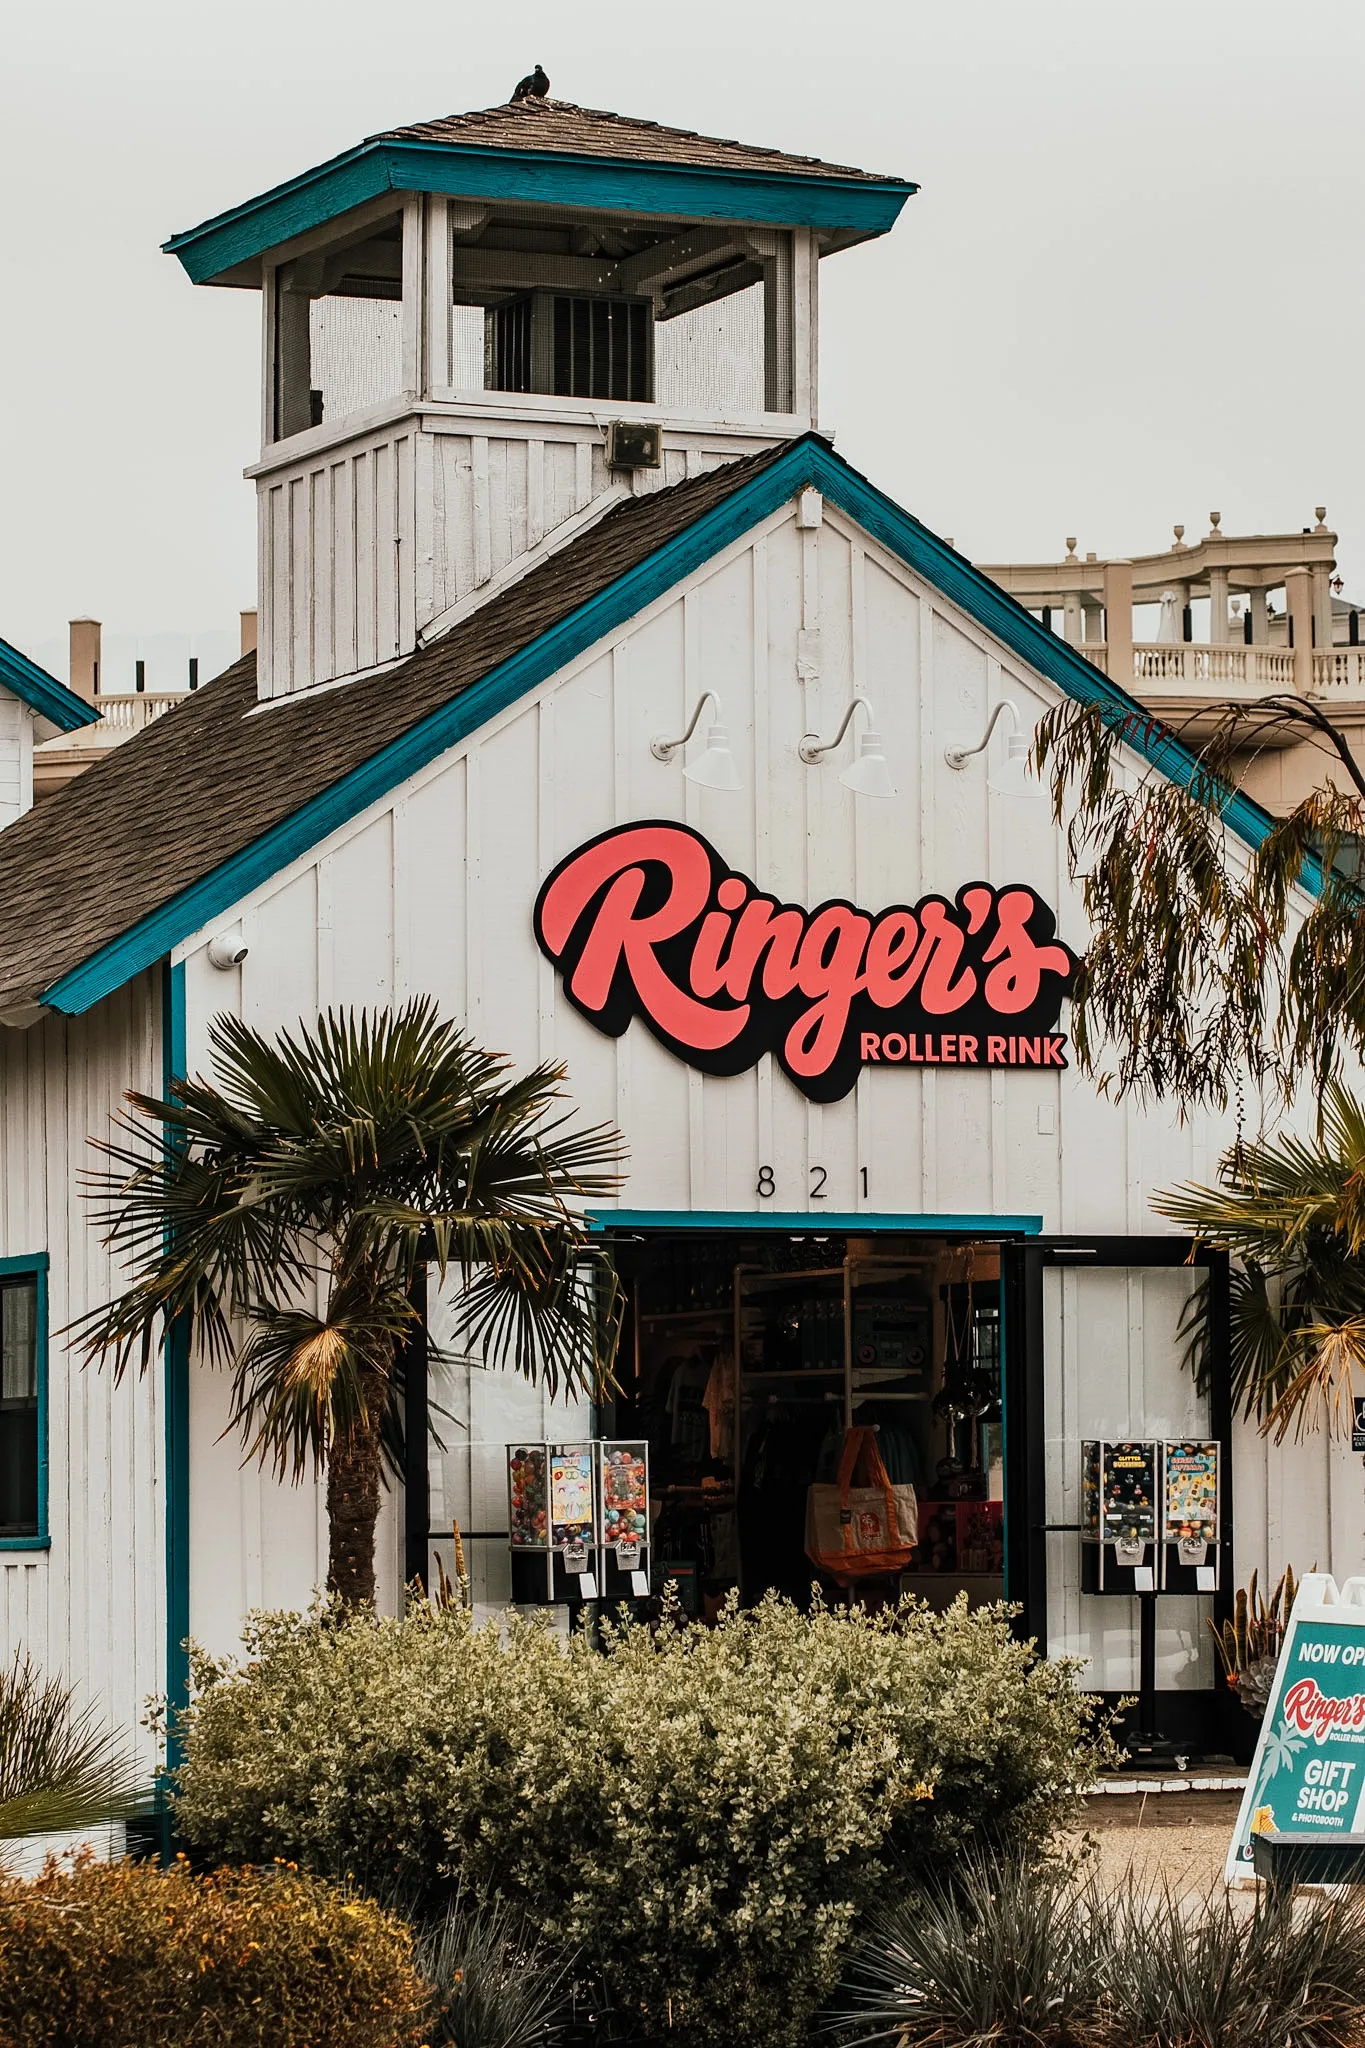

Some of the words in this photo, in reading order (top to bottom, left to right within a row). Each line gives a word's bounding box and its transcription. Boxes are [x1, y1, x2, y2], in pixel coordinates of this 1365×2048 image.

[541, 827, 1070, 1077] Ringer's
[860, 1032, 979, 1063] ROLLER
[987, 1035, 1066, 1065] RINK
[757, 1165, 868, 1199] 821
[1298, 1642, 1342, 1664] NOW
[1341, 1645, 1365, 1666] OP
[1284, 1679, 1365, 1739] Ringer's
[1329, 1732, 1351, 1742] ROLLER
[1304, 1759, 1356, 1788] GIFT
[1297, 1786, 1349, 1812] SHOP
[1291, 1812, 1299, 1822] &
[1297, 1813, 1344, 1827] PHOTOBOOTH
